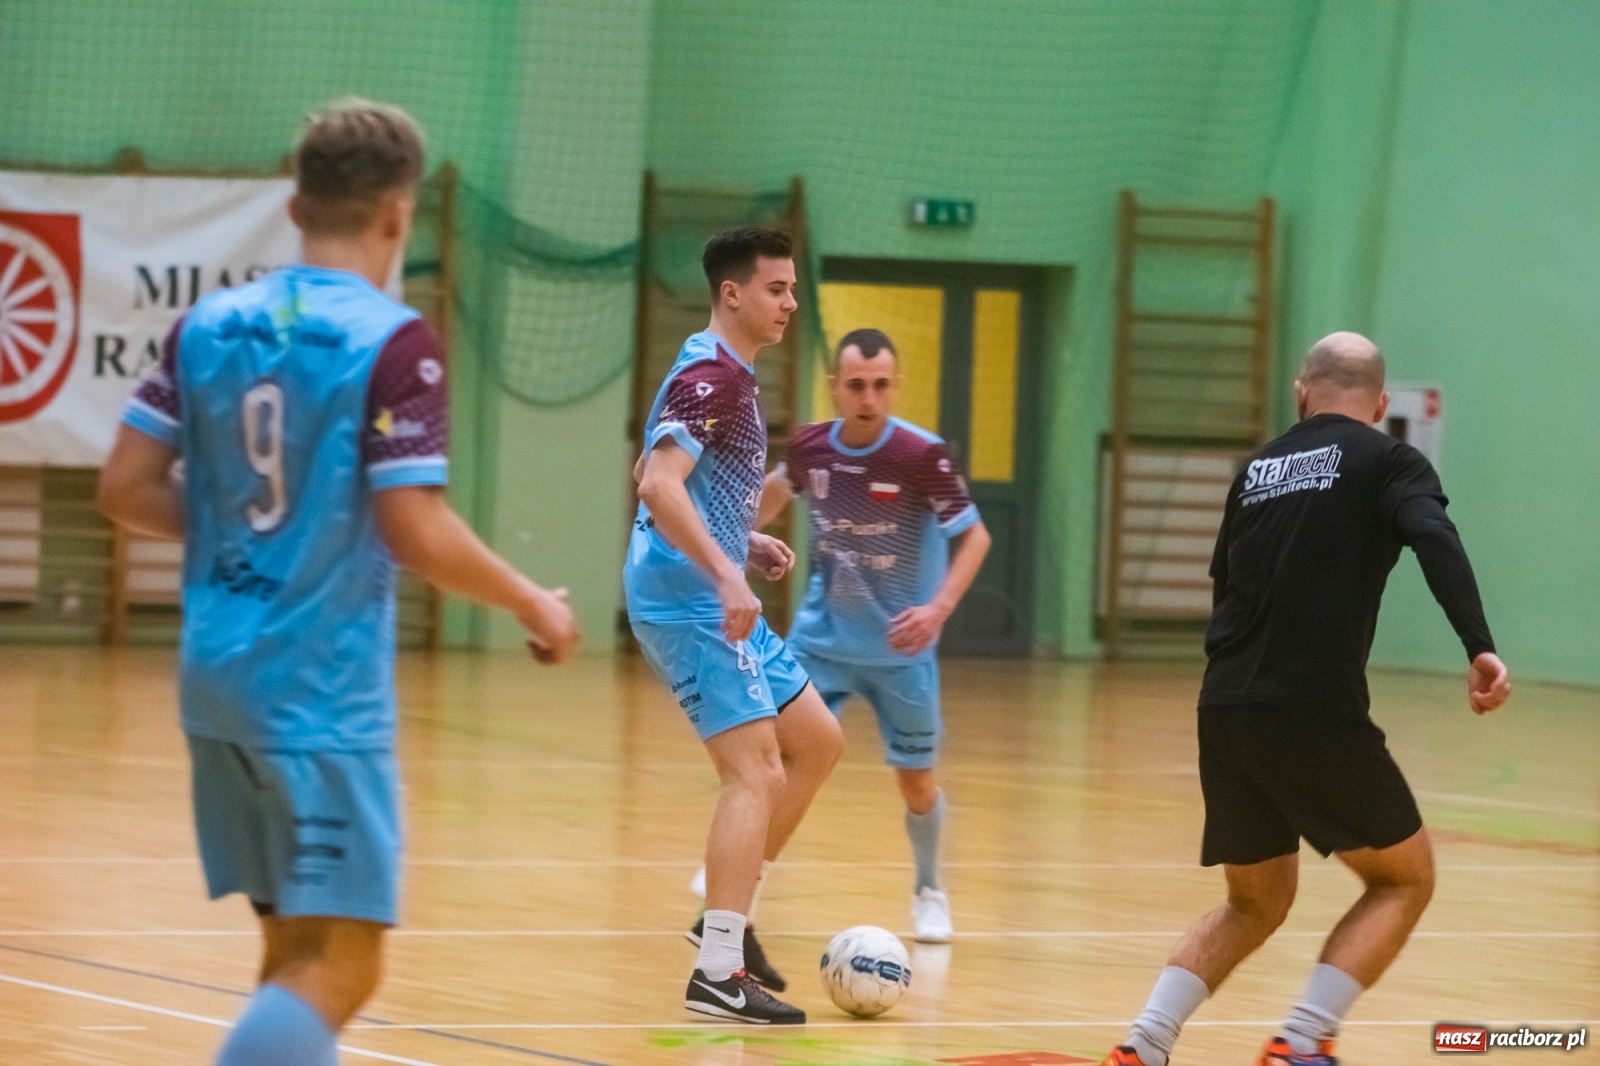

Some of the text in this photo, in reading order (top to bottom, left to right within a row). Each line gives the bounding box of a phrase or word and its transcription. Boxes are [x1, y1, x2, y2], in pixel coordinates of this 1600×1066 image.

[243, 384, 287, 532] 9
[1244, 444, 1342, 491] Staltech
[736, 640, 759, 678] 4
